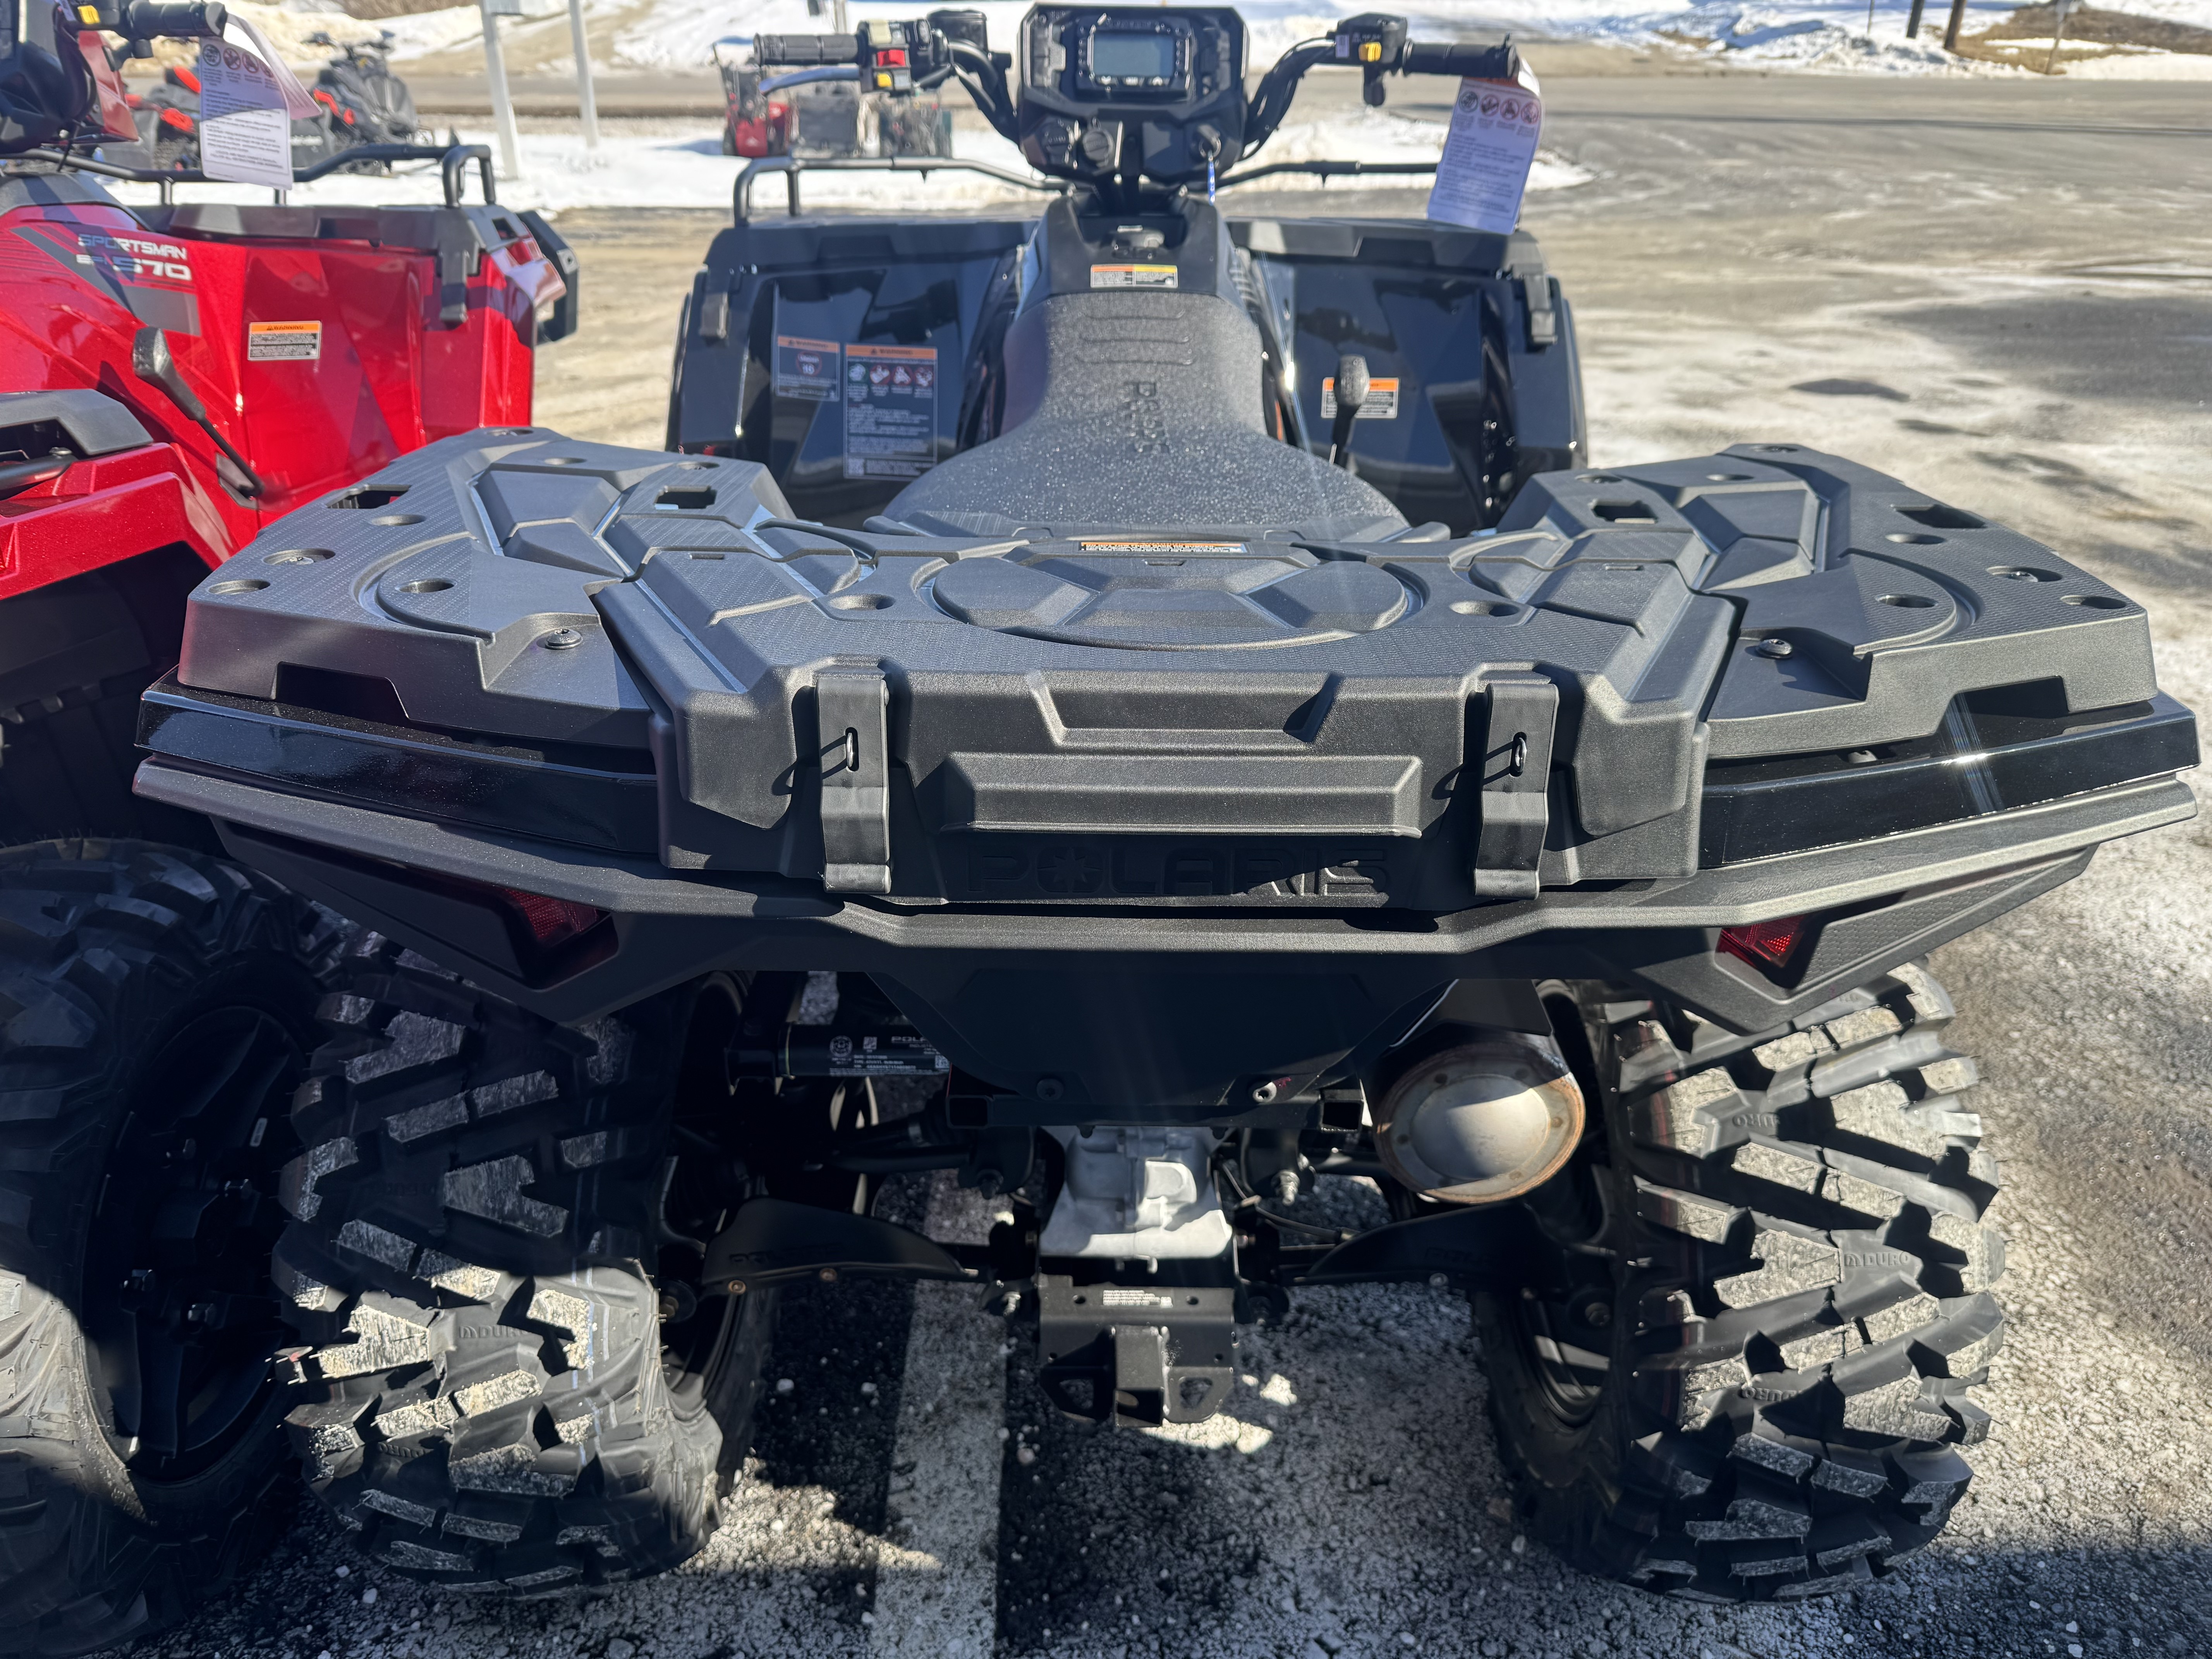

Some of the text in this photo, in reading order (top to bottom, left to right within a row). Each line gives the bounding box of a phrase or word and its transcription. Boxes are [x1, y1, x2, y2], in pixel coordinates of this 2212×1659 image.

[78, 234, 187, 260] SPORTSMAN
[112, 256, 192, 281] 570
[965, 847, 1390, 895] POLARIS
[1863, 1251, 1910, 1267] DURO
